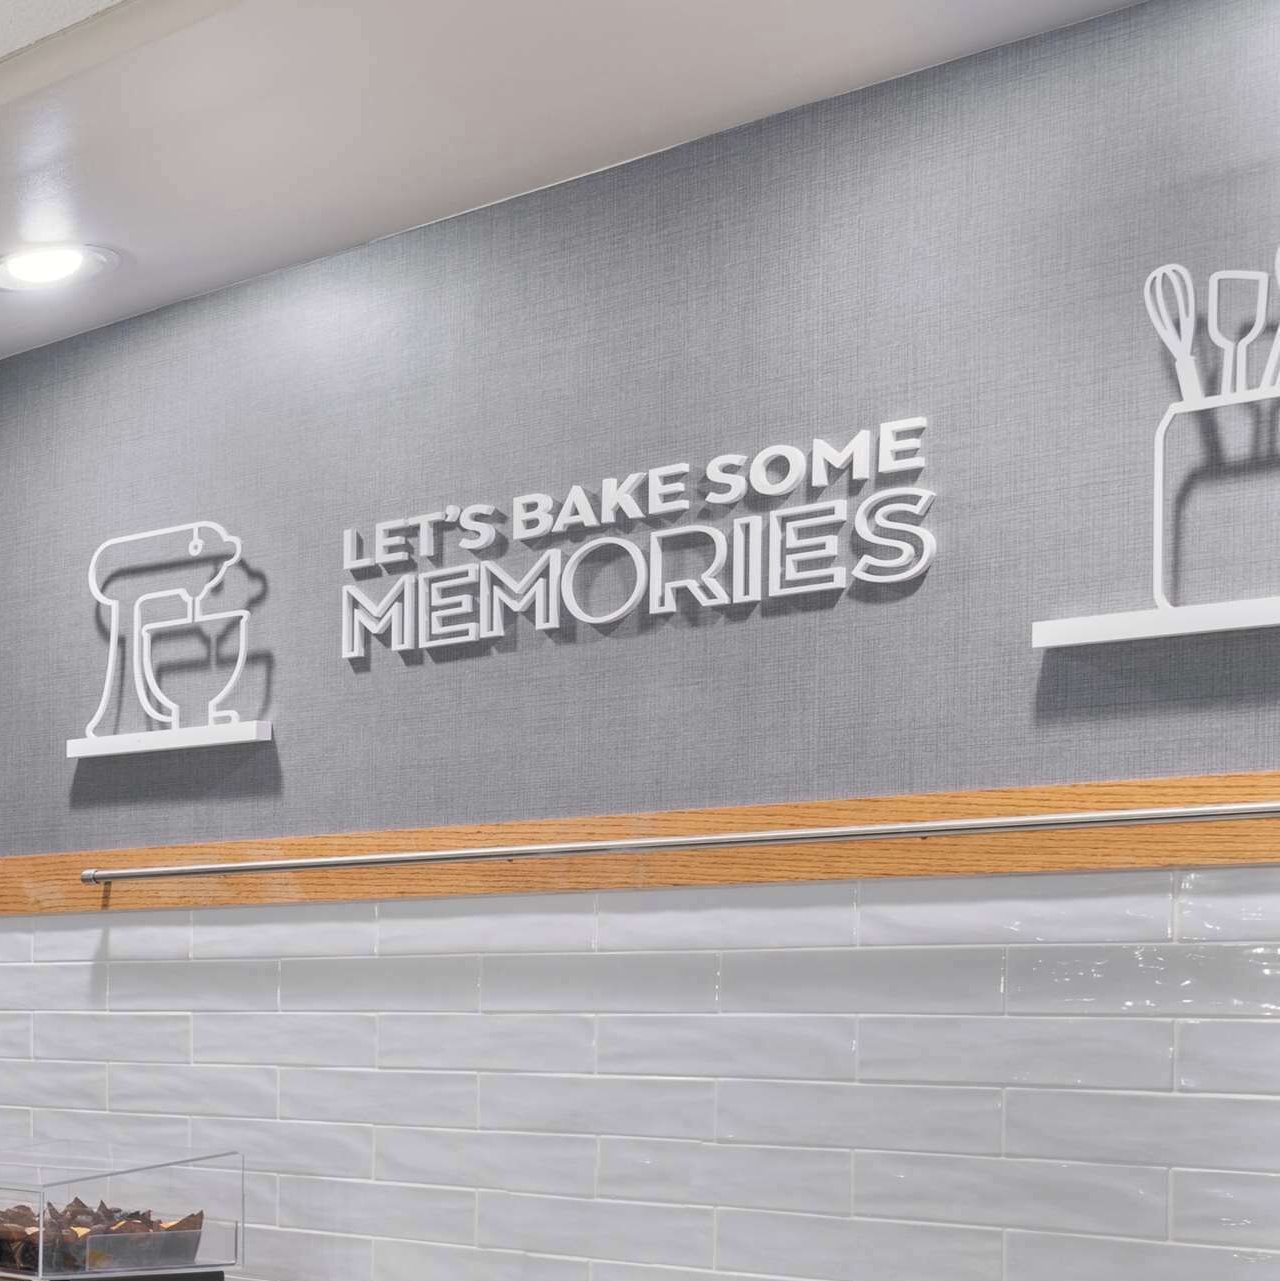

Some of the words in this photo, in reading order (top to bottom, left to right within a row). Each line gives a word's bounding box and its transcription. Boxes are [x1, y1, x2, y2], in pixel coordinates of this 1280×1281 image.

[342, 486, 938, 659] MEMORIES
[343, 504, 496, 572] LET'S
[512, 462, 691, 541] BAKE
[705, 416, 928, 504] SOME
